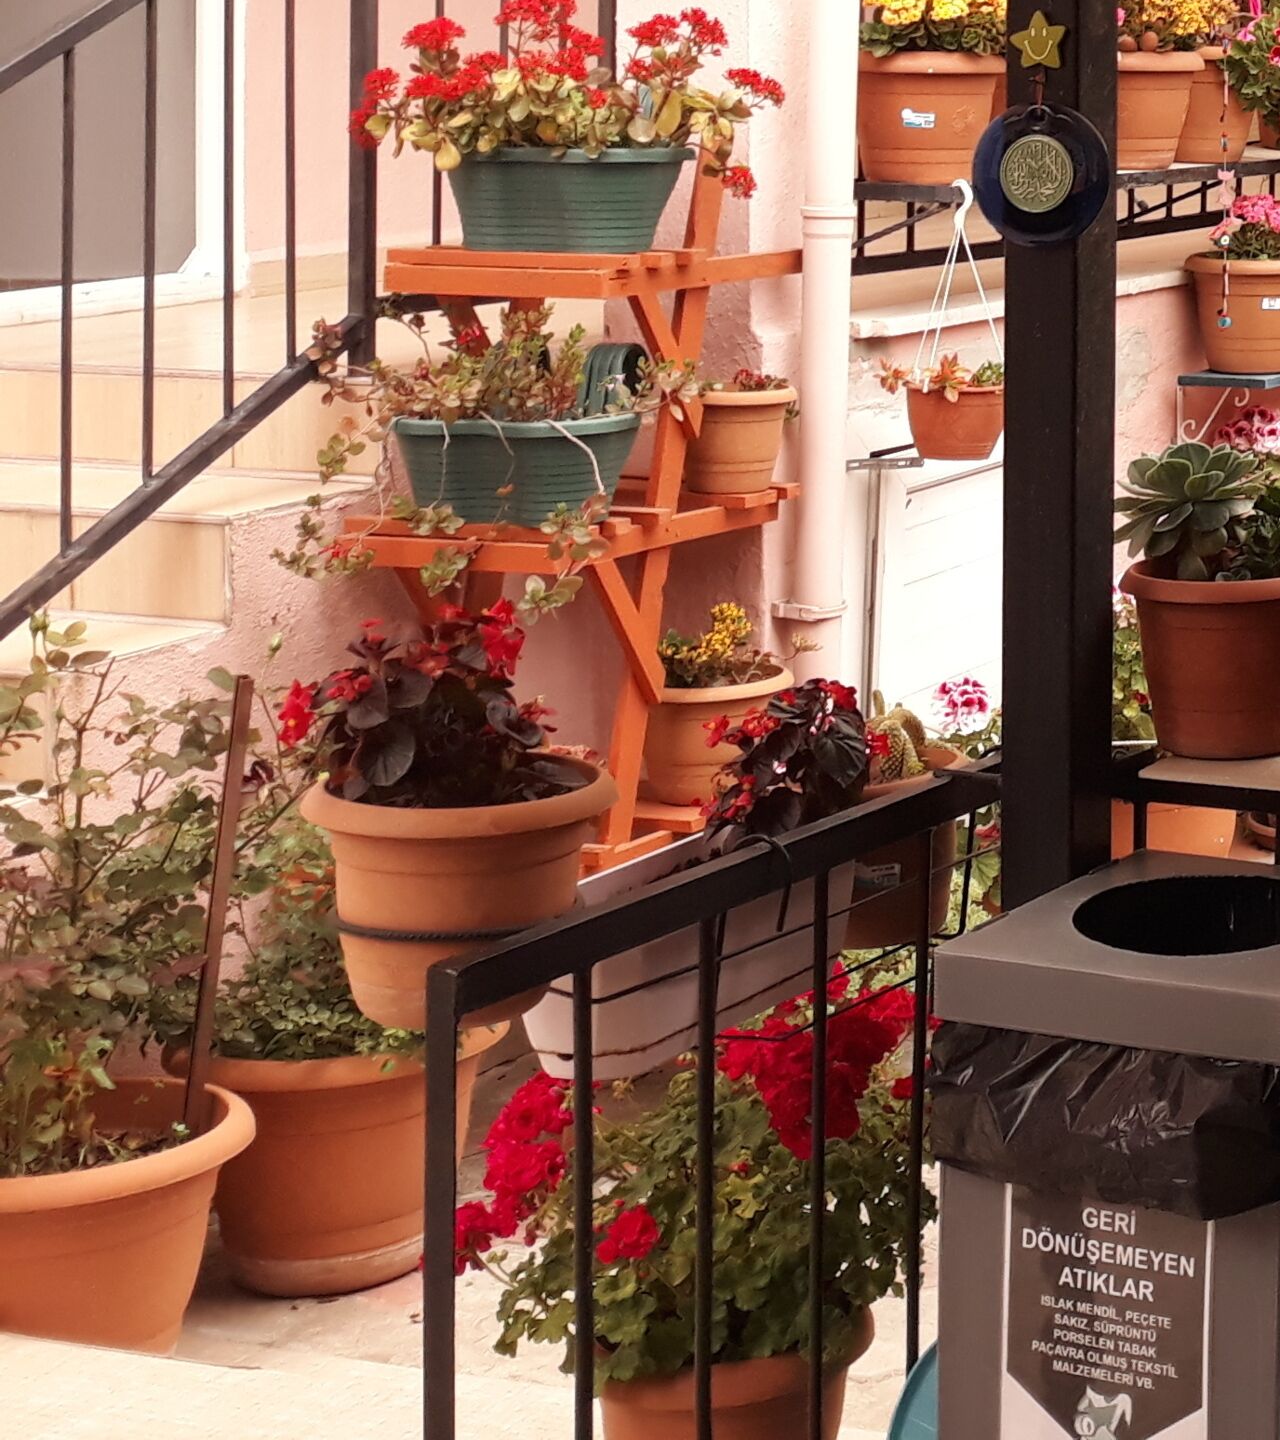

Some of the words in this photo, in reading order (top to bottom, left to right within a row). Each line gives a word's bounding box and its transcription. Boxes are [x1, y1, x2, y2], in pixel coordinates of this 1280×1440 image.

[1081, 1206, 1137, 1236] GERİ
[1022, 1226, 1195, 1278] DÖNÜŞEMEYEN
[1058, 1266, 1155, 1302] ATIKLAR
[1040, 1294, 1075, 1311] ISLAK
[1076, 1301, 1122, 1323] MENDİL,
[1125, 1310, 1172, 1330] PEÇETE
[1053, 1313, 1091, 1331] SAKIZ,
[1093, 1320, 1157, 1342] SÜPRÜNTÜ
[1031, 1340, 1085, 1361] PAÇAVRA
[1087, 1351, 1128, 1371] OLMUŞ
[1130, 1358, 1179, 1379] TEKSTİL
[1053, 1328, 1115, 1351] PORSELEN
[1117, 1340, 1157, 1359] TABAK
[1052, 1360, 1134, 1386] MALZEMELERİ
[1136, 1375, 1156, 1391] VB.
